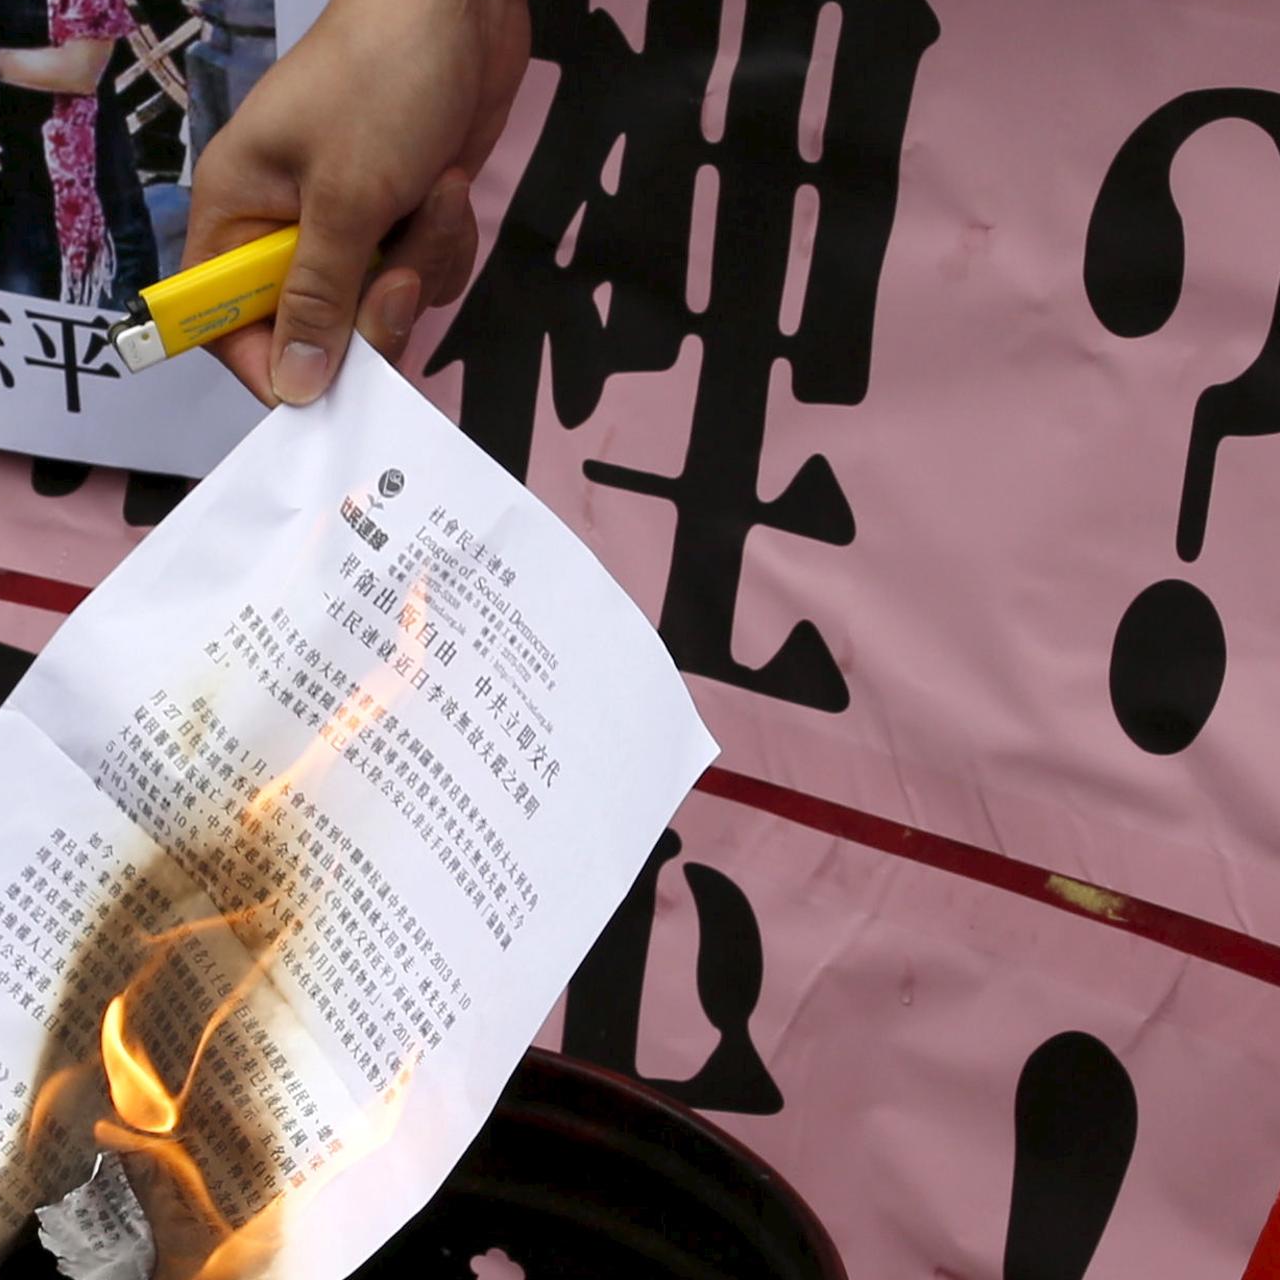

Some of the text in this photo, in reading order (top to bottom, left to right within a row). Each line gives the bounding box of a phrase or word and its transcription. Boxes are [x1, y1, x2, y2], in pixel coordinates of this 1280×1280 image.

[415, 525, 559, 671] League of Social Democrats
[427, 505, 518, 589] 社會民主連線
[472, 673, 564, 788] 中共立即交代
